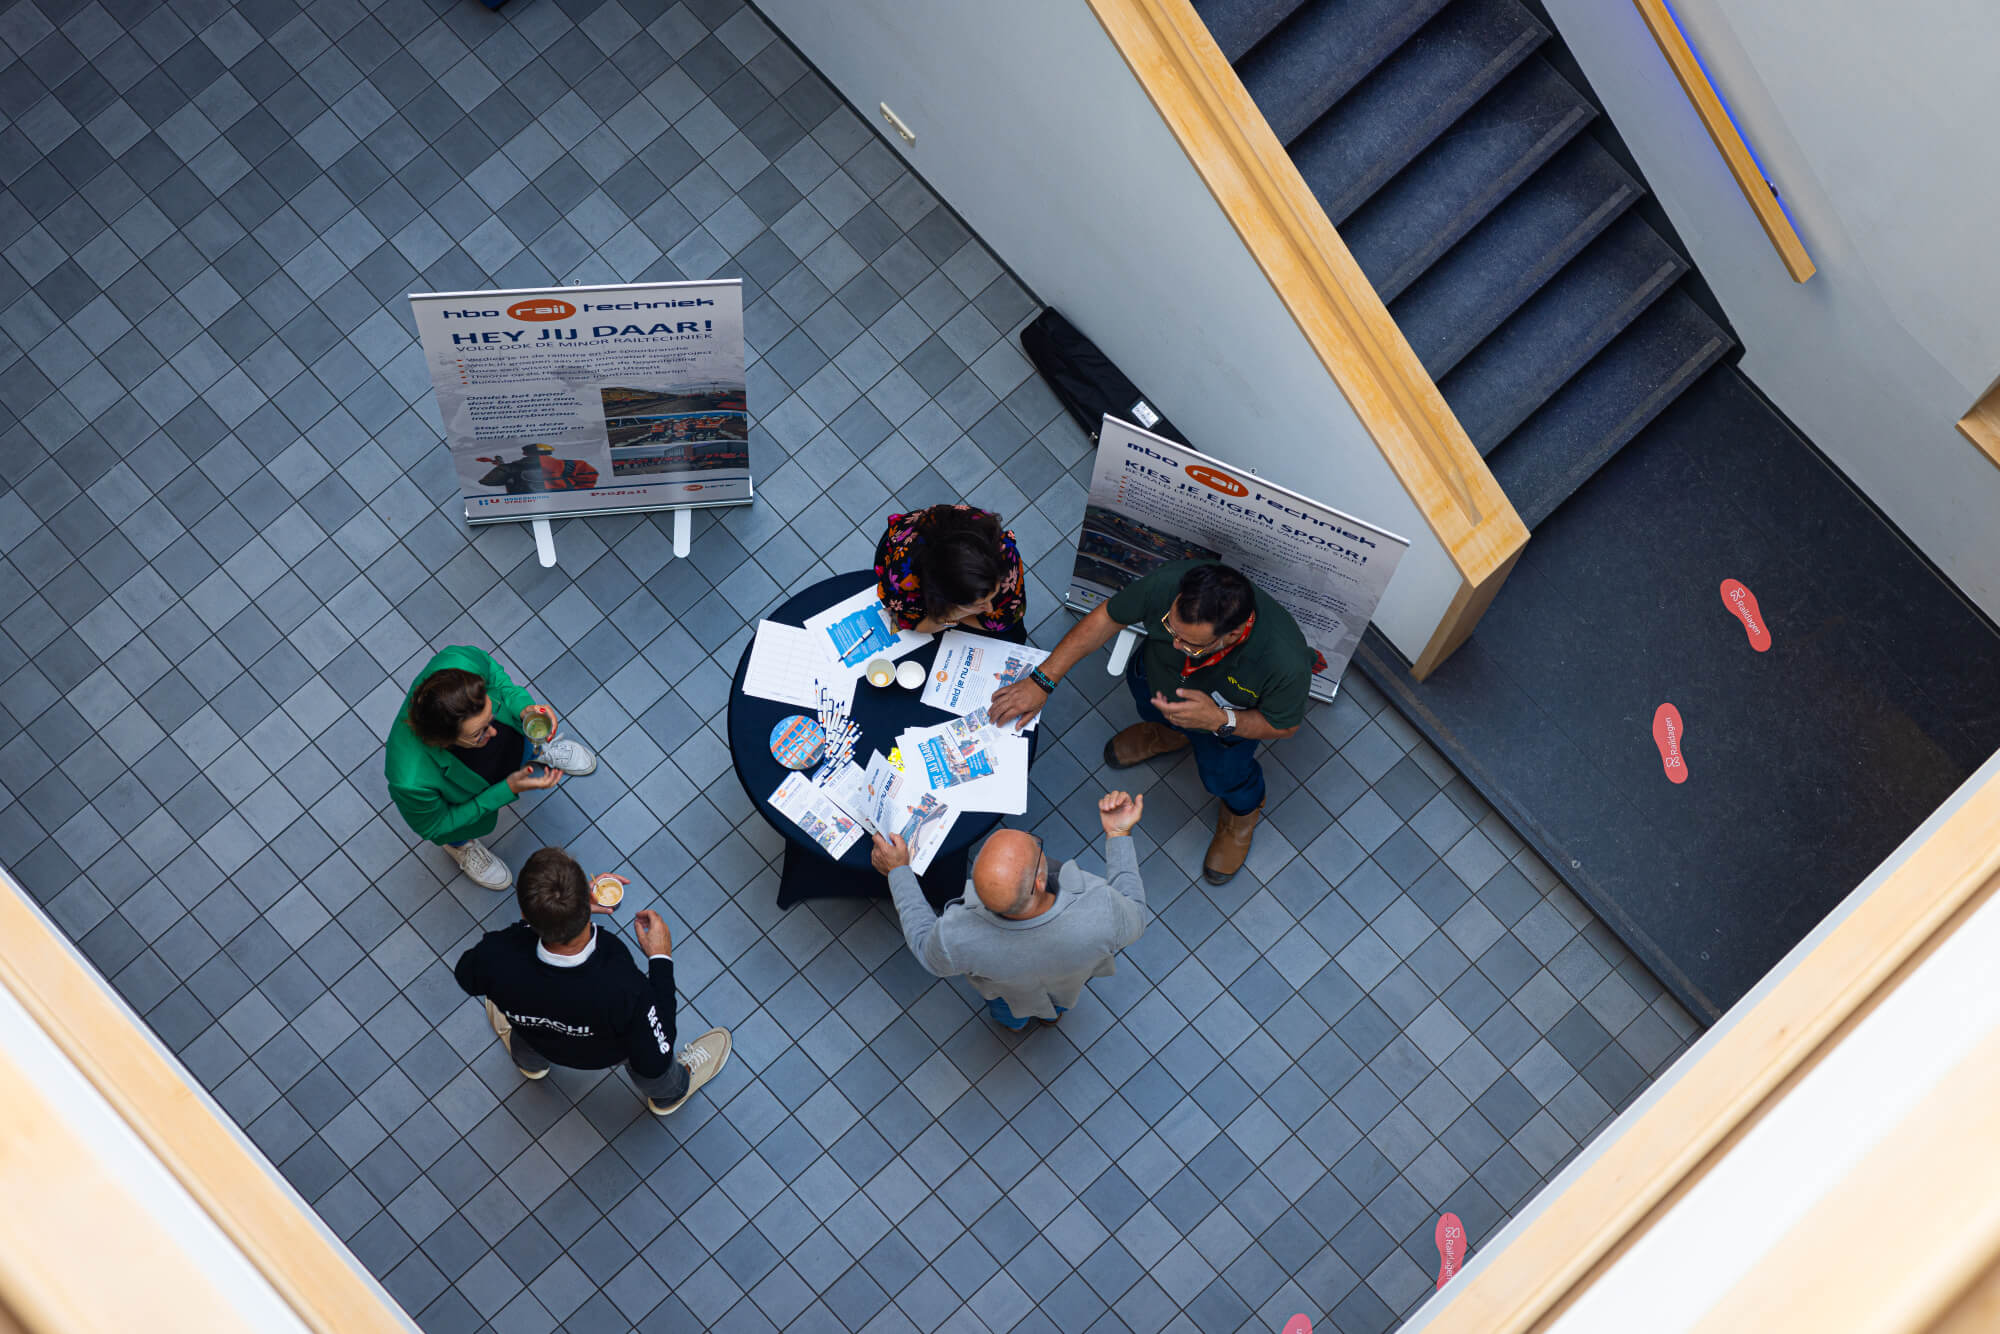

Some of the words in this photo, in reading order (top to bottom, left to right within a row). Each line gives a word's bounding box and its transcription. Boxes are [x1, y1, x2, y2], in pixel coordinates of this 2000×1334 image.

[442, 310, 500, 318] hbo
[515, 304, 566, 316] rail
[584, 298, 714, 312] techniek
[452, 330, 525, 344] HEY
[538, 328, 578, 340] JIJ
[592, 320, 712, 338] DAAR!
[560, 338, 608, 348] MINOR
[614, 334, 712, 342] RAILTECHNIEK
[1127, 442, 1178, 468] mbo
[1192, 470, 1239, 493] rail
[1256, 493, 1376, 548] techniek
[1126, 460, 1170, 484] KIES
[1177, 483, 1200, 494] JE
[1208, 493, 1274, 525] EIGEN
[1280, 524, 1368, 563] SPOOR!
[1736, 600, 1760, 636] Raildagen
[1666, 717, 1679, 756] Raildagen
[506, 1010, 590, 1034] HITACHI
